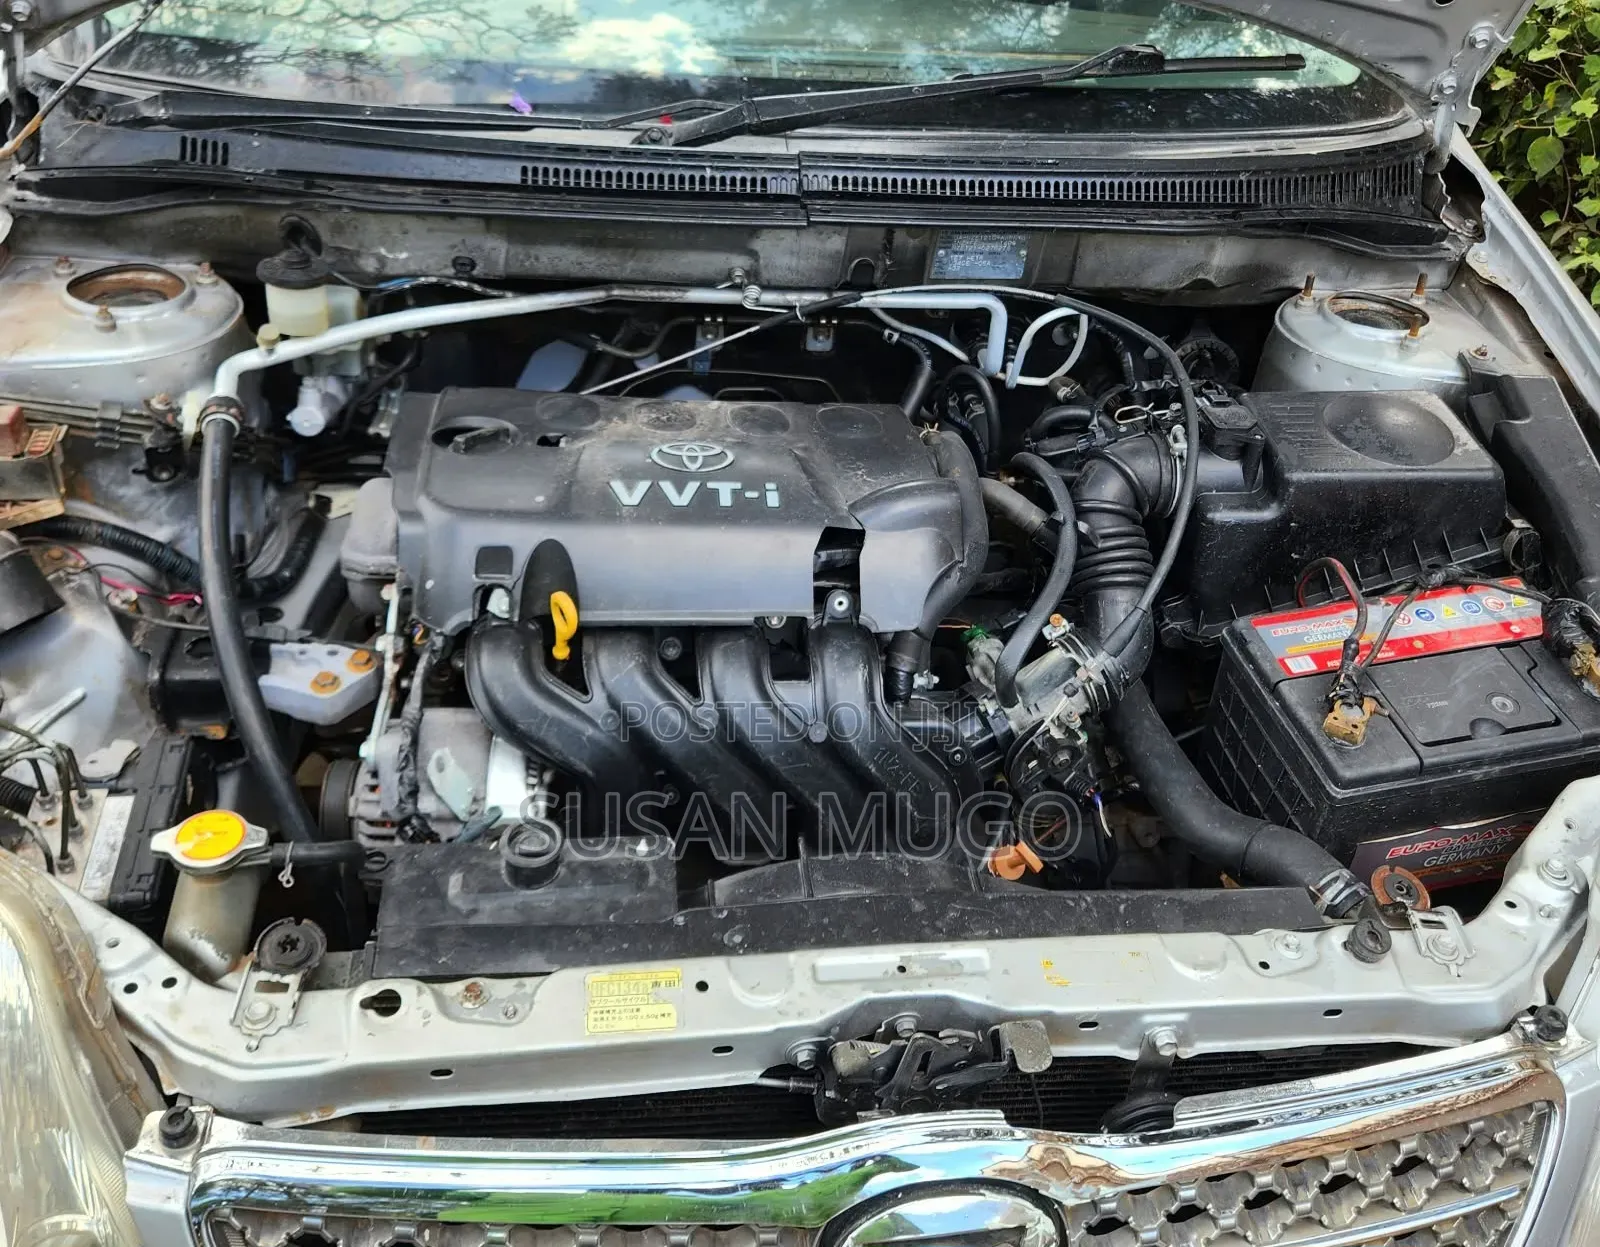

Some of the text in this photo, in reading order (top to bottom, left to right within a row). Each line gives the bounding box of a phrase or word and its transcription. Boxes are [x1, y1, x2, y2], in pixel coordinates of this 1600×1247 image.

[608, 480, 780, 508] VVT-i
[1385, 826, 1514, 859] EURO-MAX
[1423, 844, 1506, 867] GERMANY
